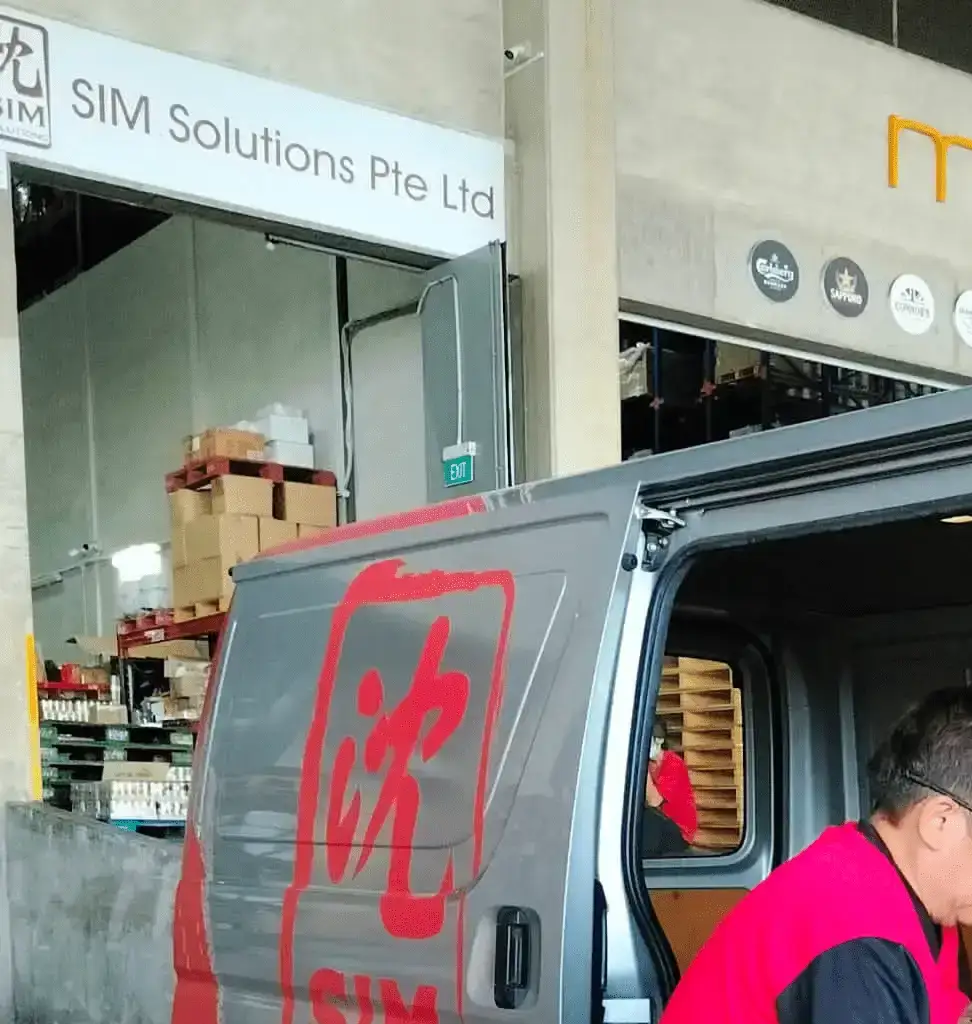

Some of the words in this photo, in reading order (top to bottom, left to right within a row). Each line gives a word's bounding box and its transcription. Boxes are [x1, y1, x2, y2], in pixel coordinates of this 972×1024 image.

[71, 78, 151, 135] SIM
[168, 103, 355, 184] Solutions
[370, 155, 428, 201] Pte
[442, 174, 495, 220] Ltd
[450, 461, 467, 481] EXIT
